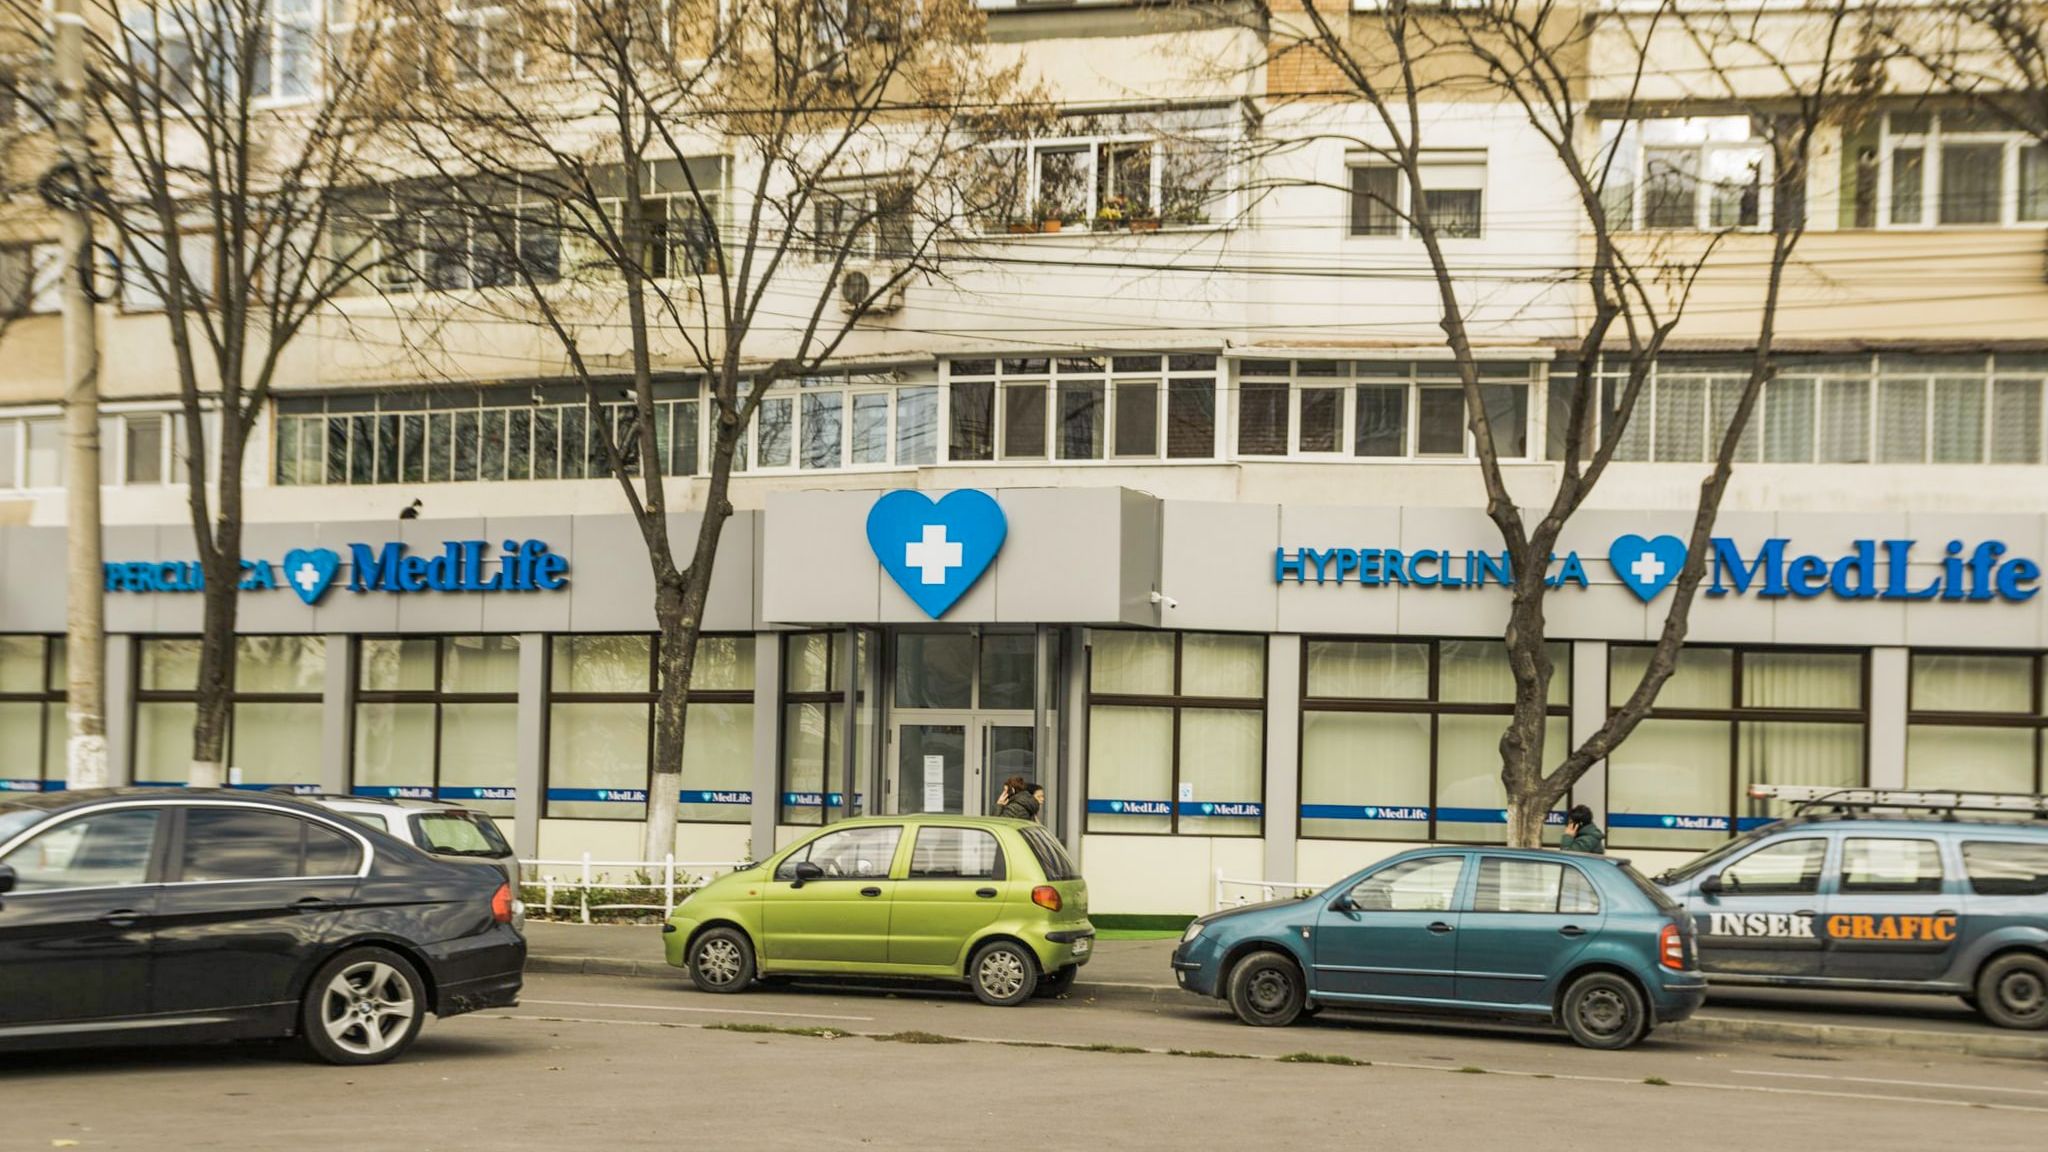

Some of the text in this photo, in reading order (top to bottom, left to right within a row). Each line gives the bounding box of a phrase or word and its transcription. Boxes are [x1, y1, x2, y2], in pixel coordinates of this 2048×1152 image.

[347, 539, 569, 592] MedLife
[1275, 537, 2040, 600] HYPERCLINA MedLife
[607, 790, 646, 801] MedLife
[712, 792, 751, 803] MedLife
[1123, 801, 1170, 814] MedLife
[1214, 804, 1261, 816] MedLife
[1378, 808, 1427, 819] MedLife
[1675, 816, 1729, 829] MedLife
[1709, 912, 1957, 941] INSER GRAFIC
